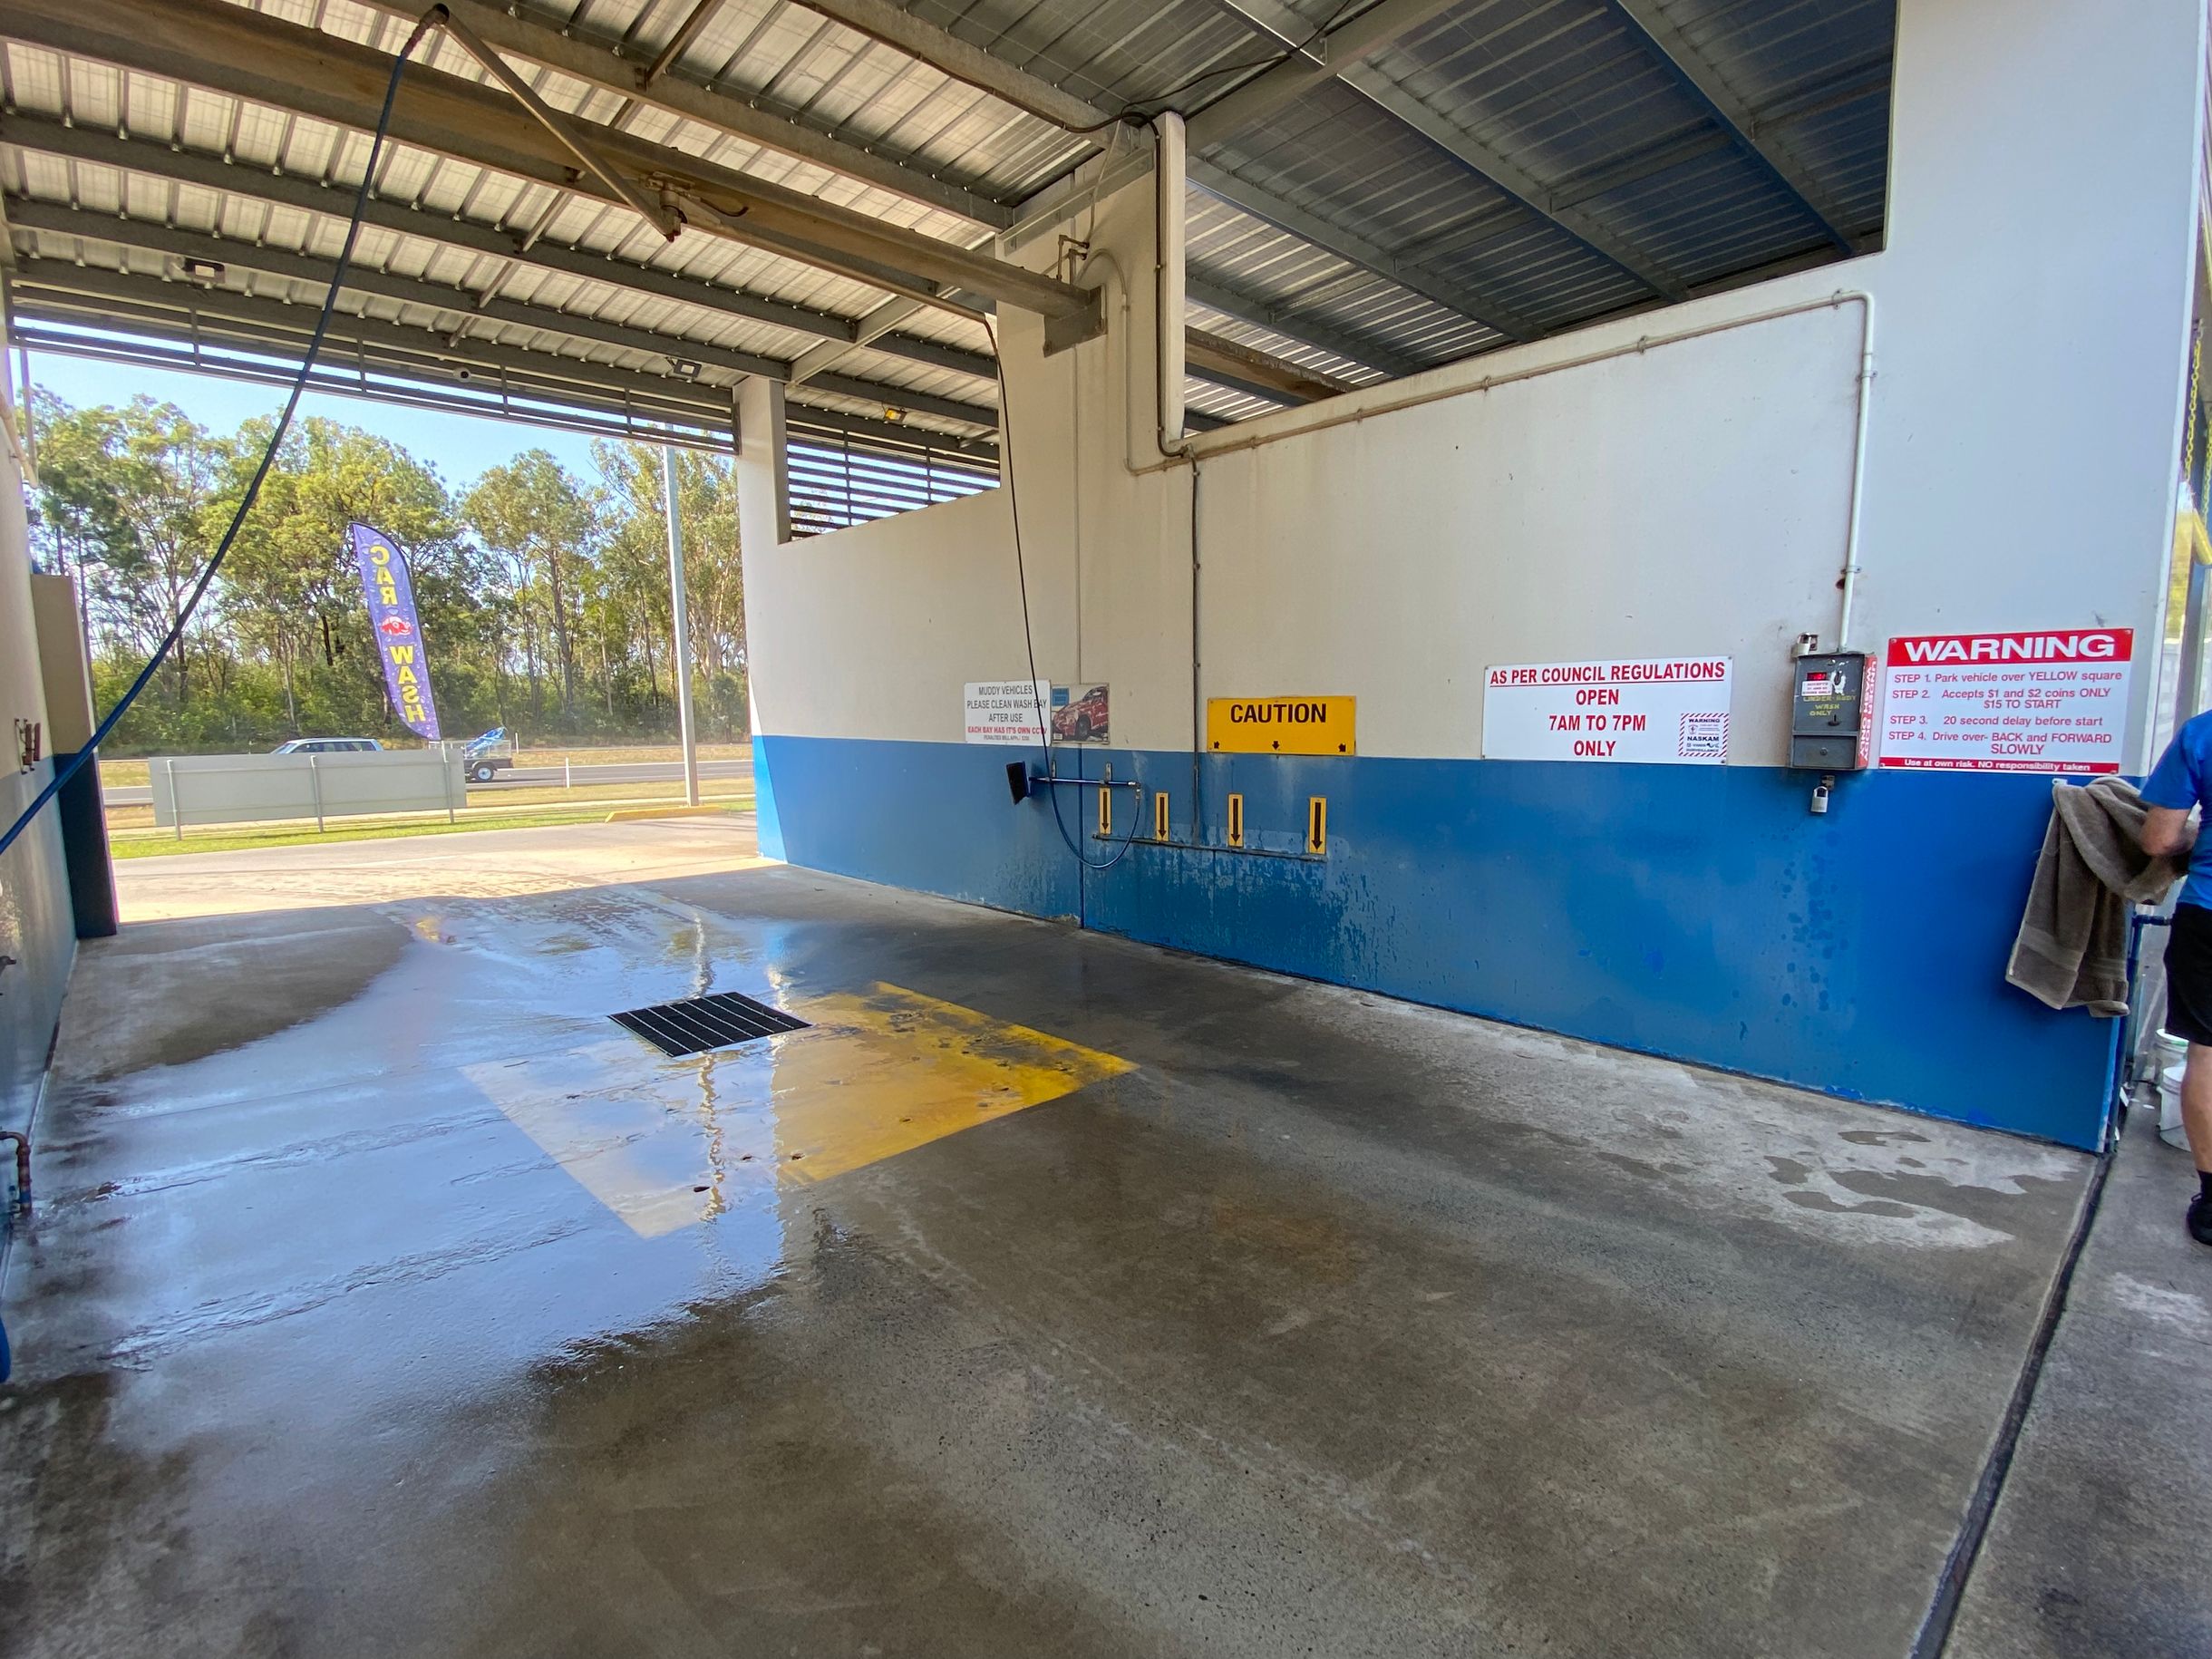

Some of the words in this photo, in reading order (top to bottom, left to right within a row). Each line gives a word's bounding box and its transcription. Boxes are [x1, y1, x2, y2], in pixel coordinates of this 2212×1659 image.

[1905, 635, 2115, 662] WARNING
[1490, 670, 1507, 684] AS
[1511, 669, 1537, 684] PER
[1542, 666, 1606, 682] COUNCIL
[1611, 662, 1725, 680] REGULATIONS
[1894, 674, 1920, 683] STEP
[1935, 674, 1957, 682] Park
[1962, 673, 1997, 682] vehicle
[2029, 672, 2078, 681] YELLOW
[2081, 672, 2122, 683] square
[979, 686, 1001, 695] MUDDY
[1002, 685, 1033, 694] VEHICLES
[1893, 690, 1918, 699] STEP
[1922, 690, 1929, 699] 2.
[1942, 689, 1984, 700] Accepts
[1988, 689, 1999, 698] $1
[2003, 689, 2023, 698] and
[2028, 689, 2042, 697] $2
[2045, 688, 2075, 697] coins
[2080, 688, 2110, 697] ONLY
[1576, 689, 1619, 705] OPEN
[967, 700, 989, 709] PLEASE
[991, 700, 1012, 708] CLEAN
[1013, 699, 1033, 708] WASH
[1984, 699, 2002, 709] $15
[2006, 700, 2020, 708] TO
[2024, 700, 2062, 708] START
[989, 713, 1008, 723] AFTER
[1010, 713, 1023, 723] USE
[1231, 703, 1326, 723] CAUTION
[1549, 715, 1580, 731] 7AM
[1586, 715, 1606, 731] TO
[1613, 714, 1645, 731] 7PM
[1890, 715, 1916, 724] STEP
[1919, 715, 1927, 724] 3.
[1944, 716, 1956, 724] 20
[1960, 716, 1999, 725] second
[2003, 716, 2031, 727] delay
[2035, 717, 2071, 725] before
[2075, 717, 2103, 725] start
[1889, 732, 1915, 740] STEP
[1918, 732, 1926, 740] 4.
[1933, 732, 1958, 741] Drive
[1993, 732, 2023, 742] BACK
[2027, 733, 2047, 742] and
[2052, 733, 2111, 742] FORWARD
[1574, 741, 1615, 756] ONLY
[1991, 744, 2044, 754] SLOWLY
[1978, 761, 1993, 769] NO
[1996, 762, 2060, 771] responsibility
